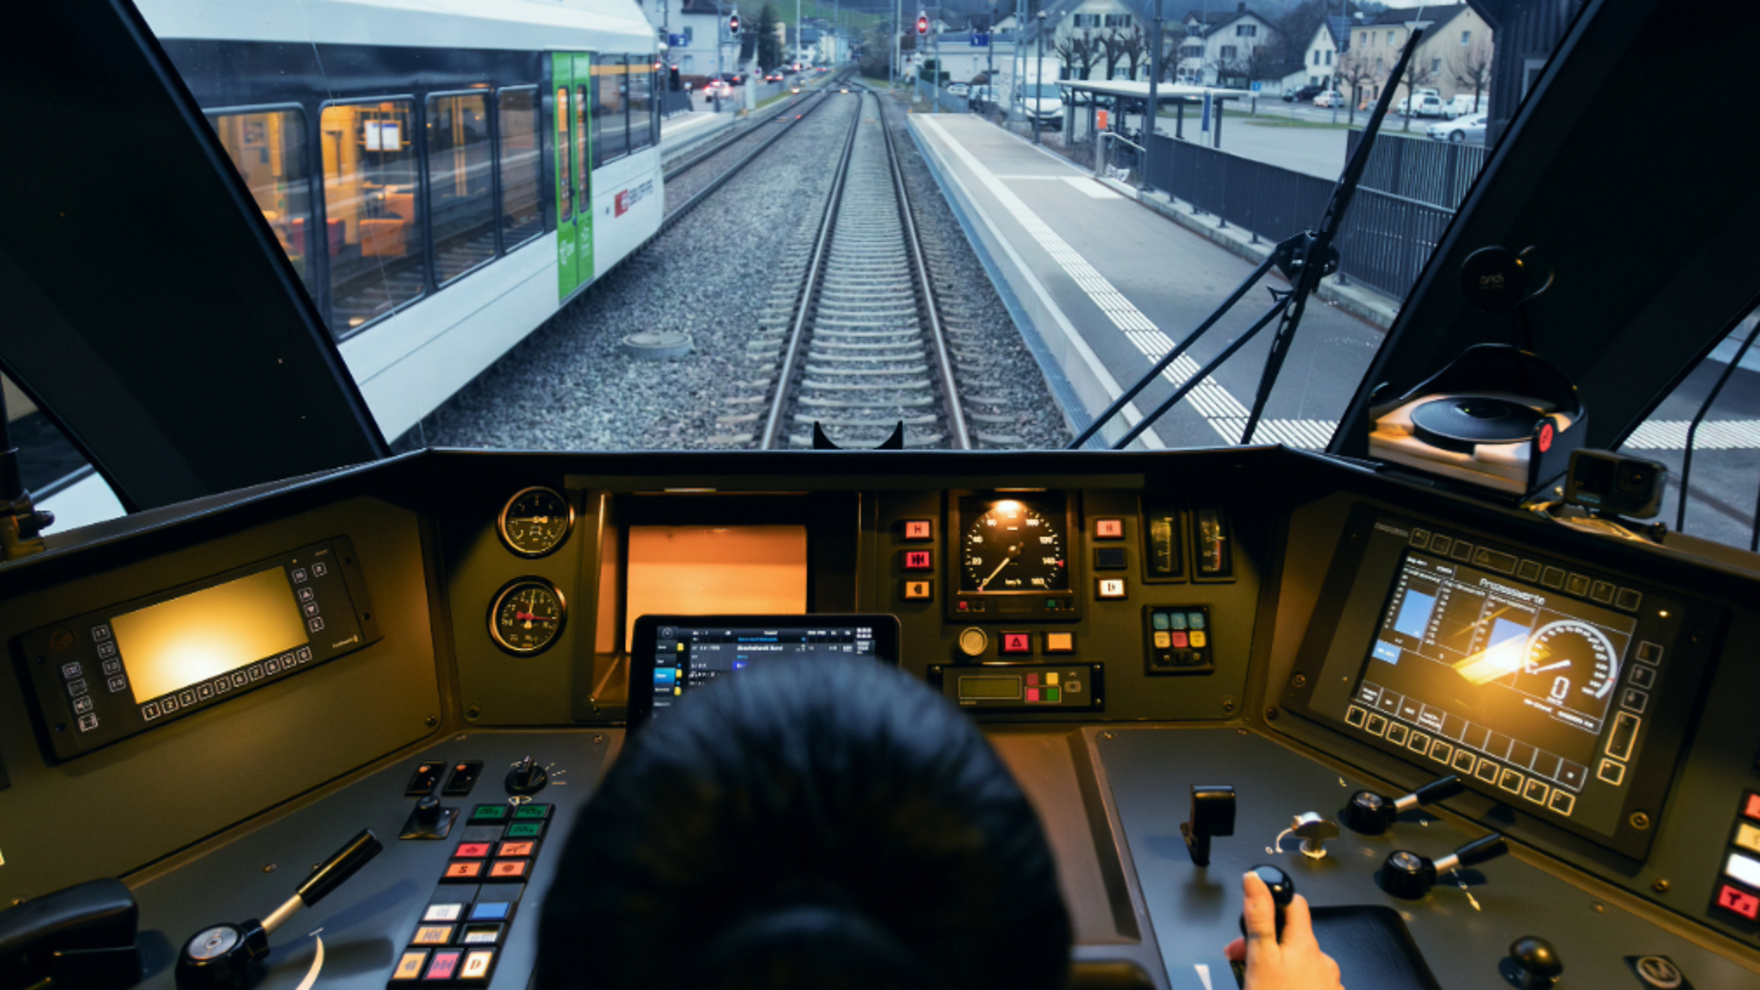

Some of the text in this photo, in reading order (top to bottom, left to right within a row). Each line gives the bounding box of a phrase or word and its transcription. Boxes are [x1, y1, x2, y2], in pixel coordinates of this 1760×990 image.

[914, 524, 922, 534] H
[1106, 523, 1113, 533] H
[1479, 578, 1545, 605] Prozesswerte
[1550, 675, 1570, 700] 0
[458, 865, 468, 874] S
[1643, 960, 1677, 979] M
